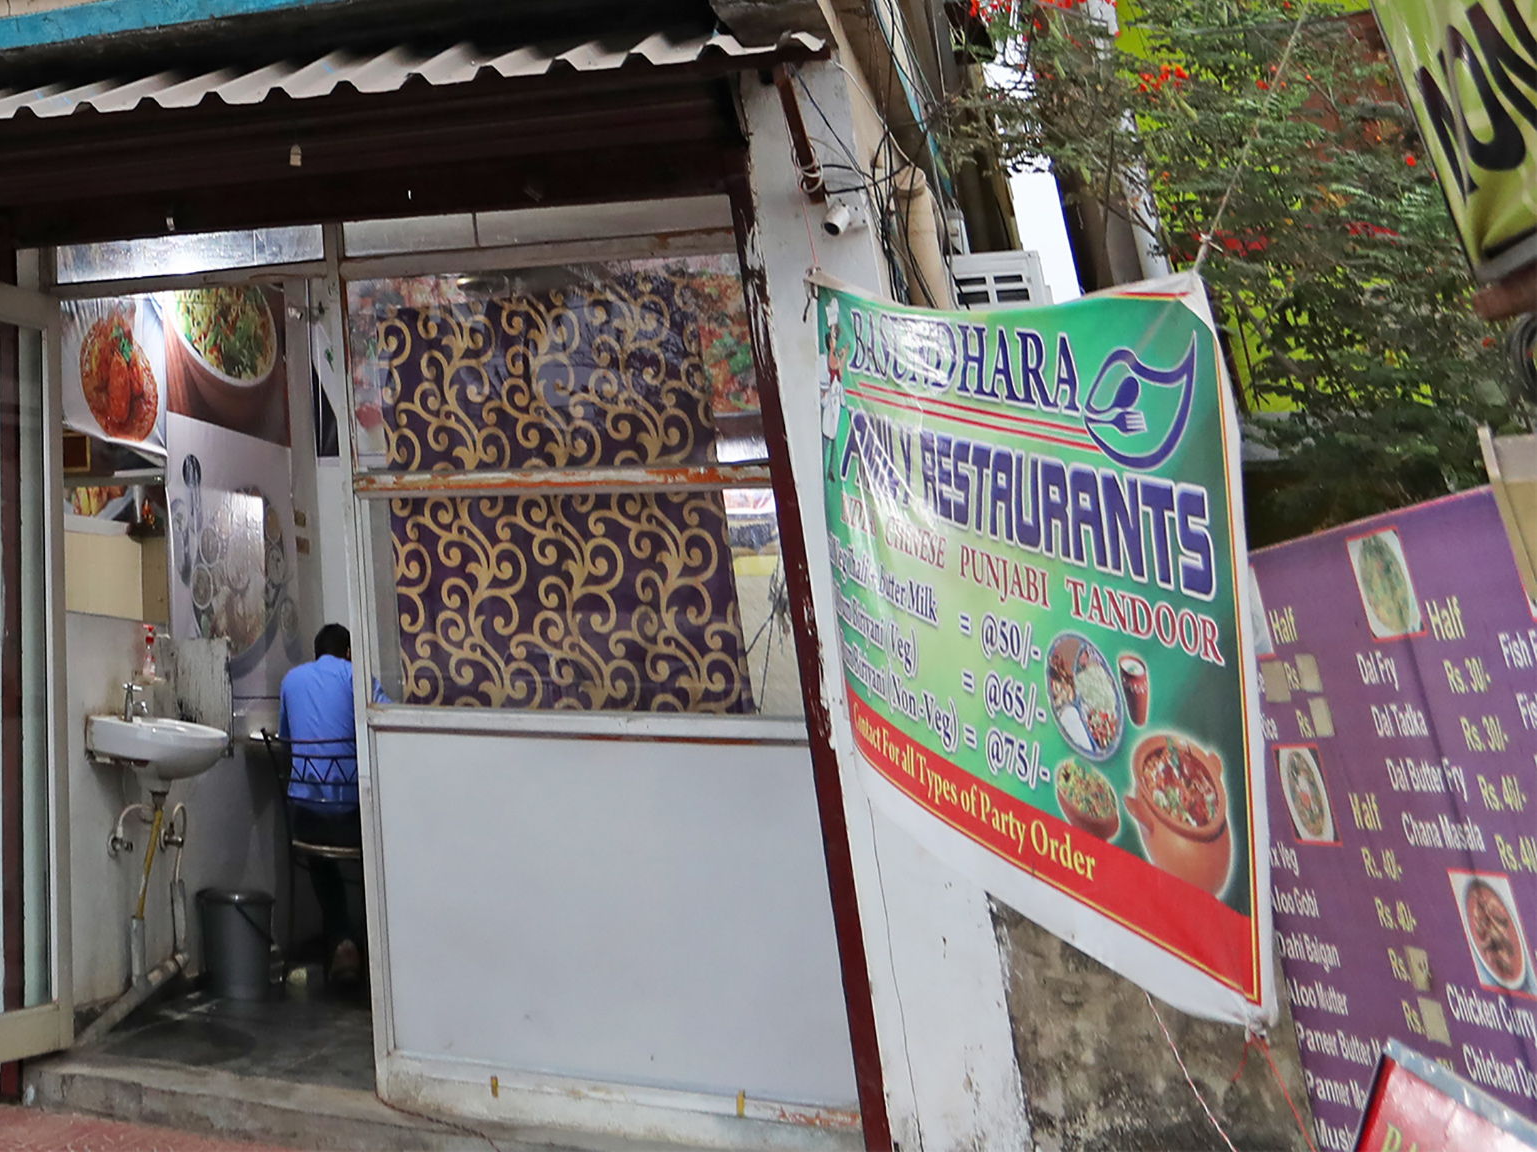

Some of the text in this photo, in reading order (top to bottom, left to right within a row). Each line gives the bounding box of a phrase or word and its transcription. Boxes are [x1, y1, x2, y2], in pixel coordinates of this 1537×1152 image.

[921, 427, 1217, 600] RESTAURANTS
[907, 580, 938, 623] Milk
[982, 617, 1042, 667] @50/-
[959, 544, 1051, 608] PUNJABI
[1065, 578, 1226, 666] TANDOOR
[1268, 605, 1299, 645] Half
[1425, 595, 1467, 642] Half
[1356, 652, 1380, 685] Dal
[1374, 650, 1399, 691] Fry
[1498, 631, 1534, 670] Fish
[984, 673, 1047, 730] @65/-
[1369, 704, 1393, 738] Dal
[986, 728, 1051, 788] @75/-
[1384, 757, 1411, 793] Dal
[1405, 758, 1446, 794] Butter
[1441, 758, 1468, 803] Fry
[882, 727, 901, 762] For
[901, 744, 915, 778] all
[916, 753, 959, 806] Types
[961, 783, 978, 818] of
[979, 789, 1027, 854] Party
[1030, 820, 1097, 882] Order
[1347, 791, 1383, 832] Half
[1401, 810, 1443, 849] Chana
[1437, 813, 1487, 853] Masala
[1292, 887, 1320, 918] Gobi
[1445, 983, 1537, 1050] Chicken Curry
[1335, 1028, 1374, 1067] Butter
[1462, 1042, 1521, 1095] Chicken
